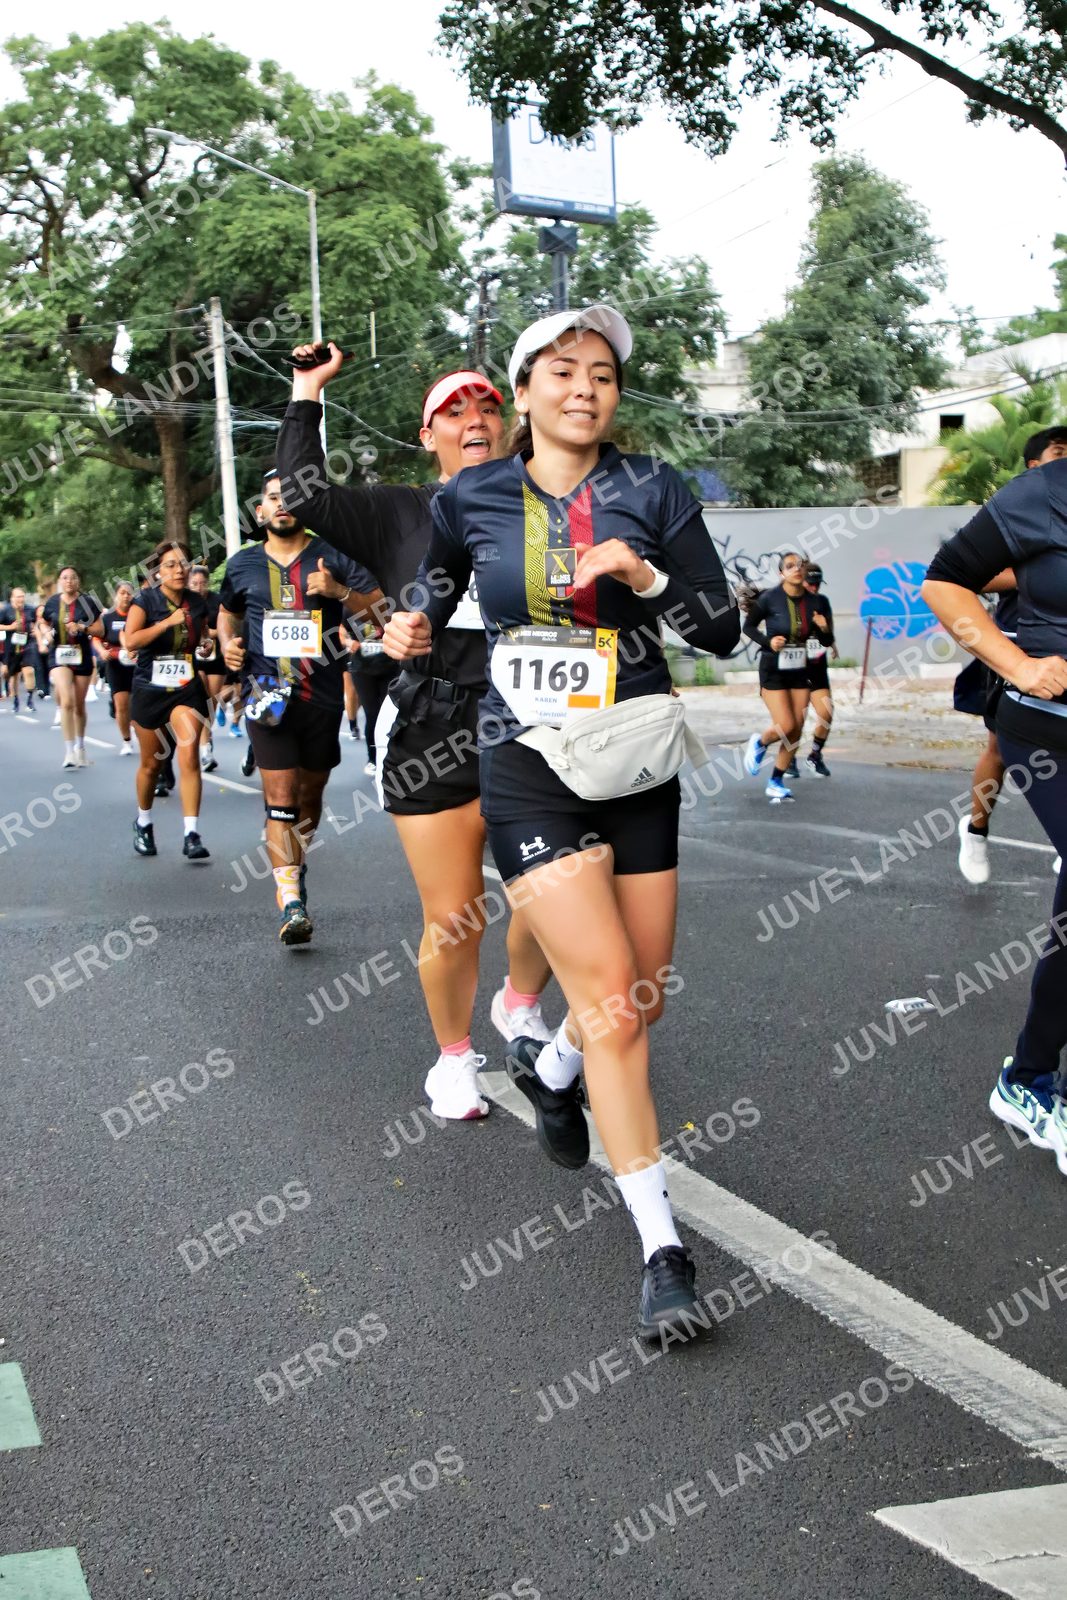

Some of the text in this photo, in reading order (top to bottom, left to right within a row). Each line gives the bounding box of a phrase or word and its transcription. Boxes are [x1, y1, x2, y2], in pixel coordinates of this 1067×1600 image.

[271, 626, 309, 641] 6588
[597, 637, 613, 649] 5K
[784, 651, 804, 660] 7617
[159, 663, 186, 676] 7574
[508, 657, 590, 693] 1169
